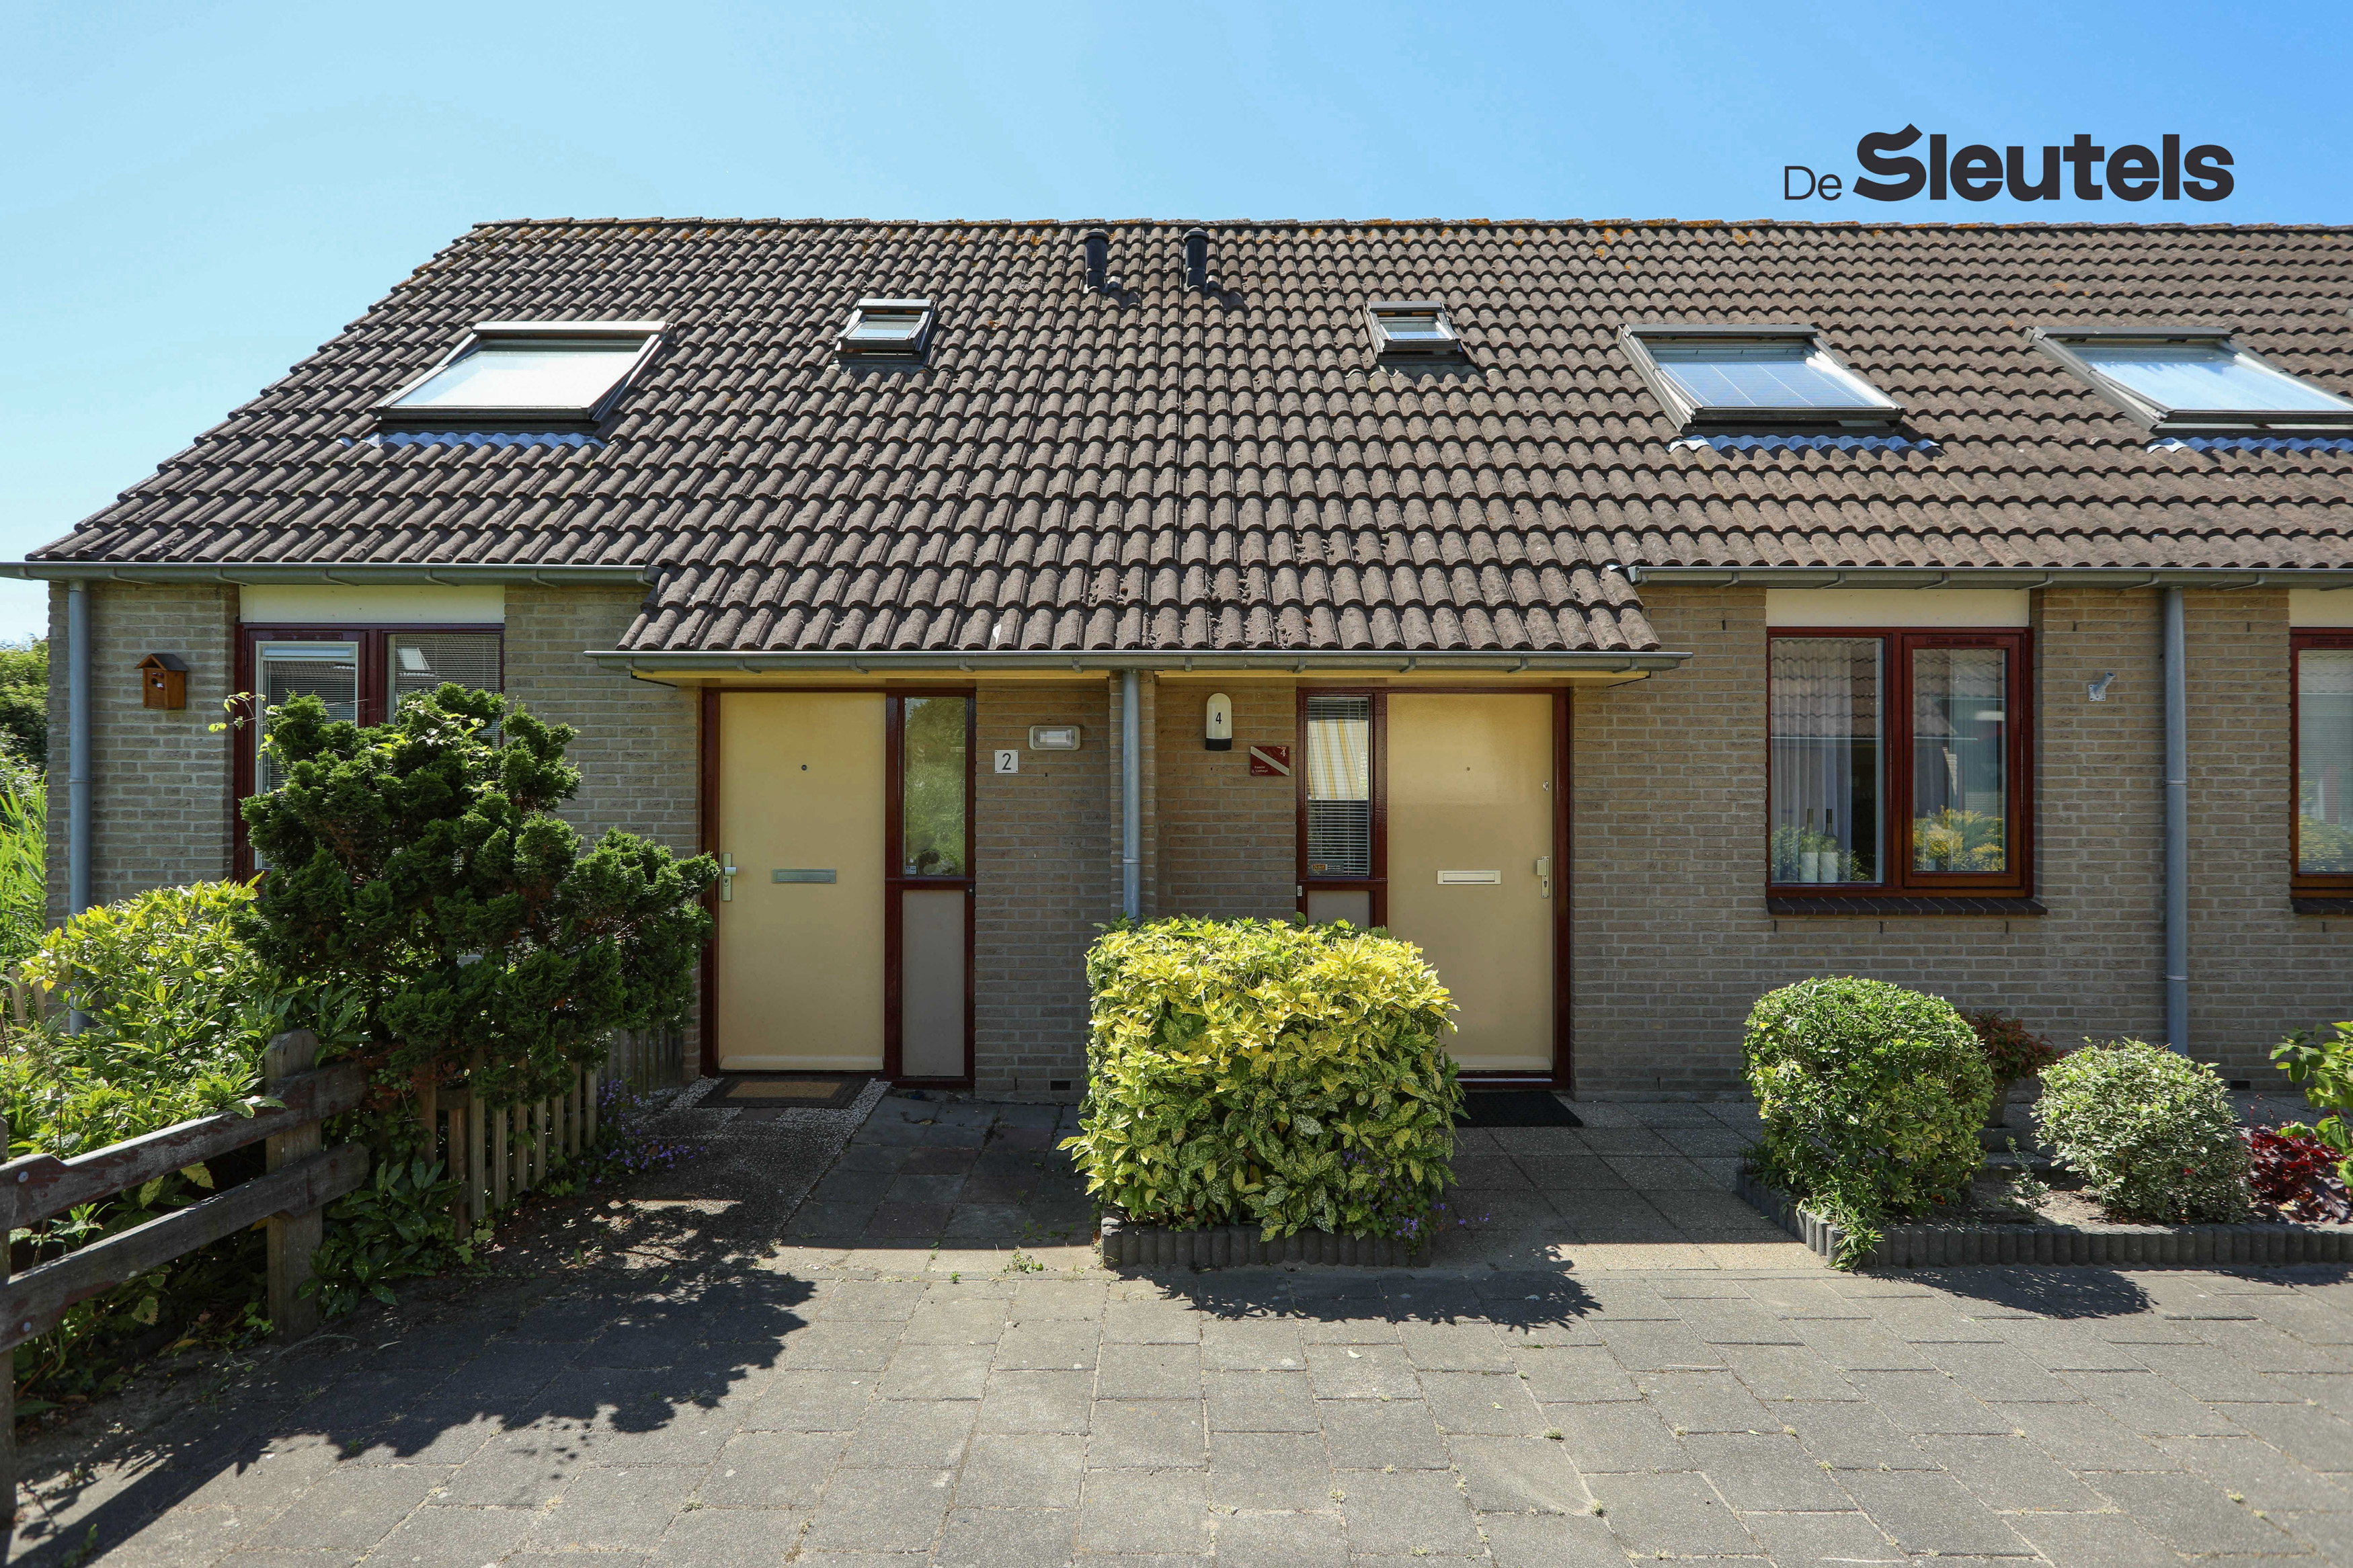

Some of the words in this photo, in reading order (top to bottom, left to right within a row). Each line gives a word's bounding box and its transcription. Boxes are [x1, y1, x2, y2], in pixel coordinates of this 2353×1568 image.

[1215, 712, 1222, 724] 4
[1280, 749, 1286, 757] 4
[1002, 753, 1012, 770] 2
